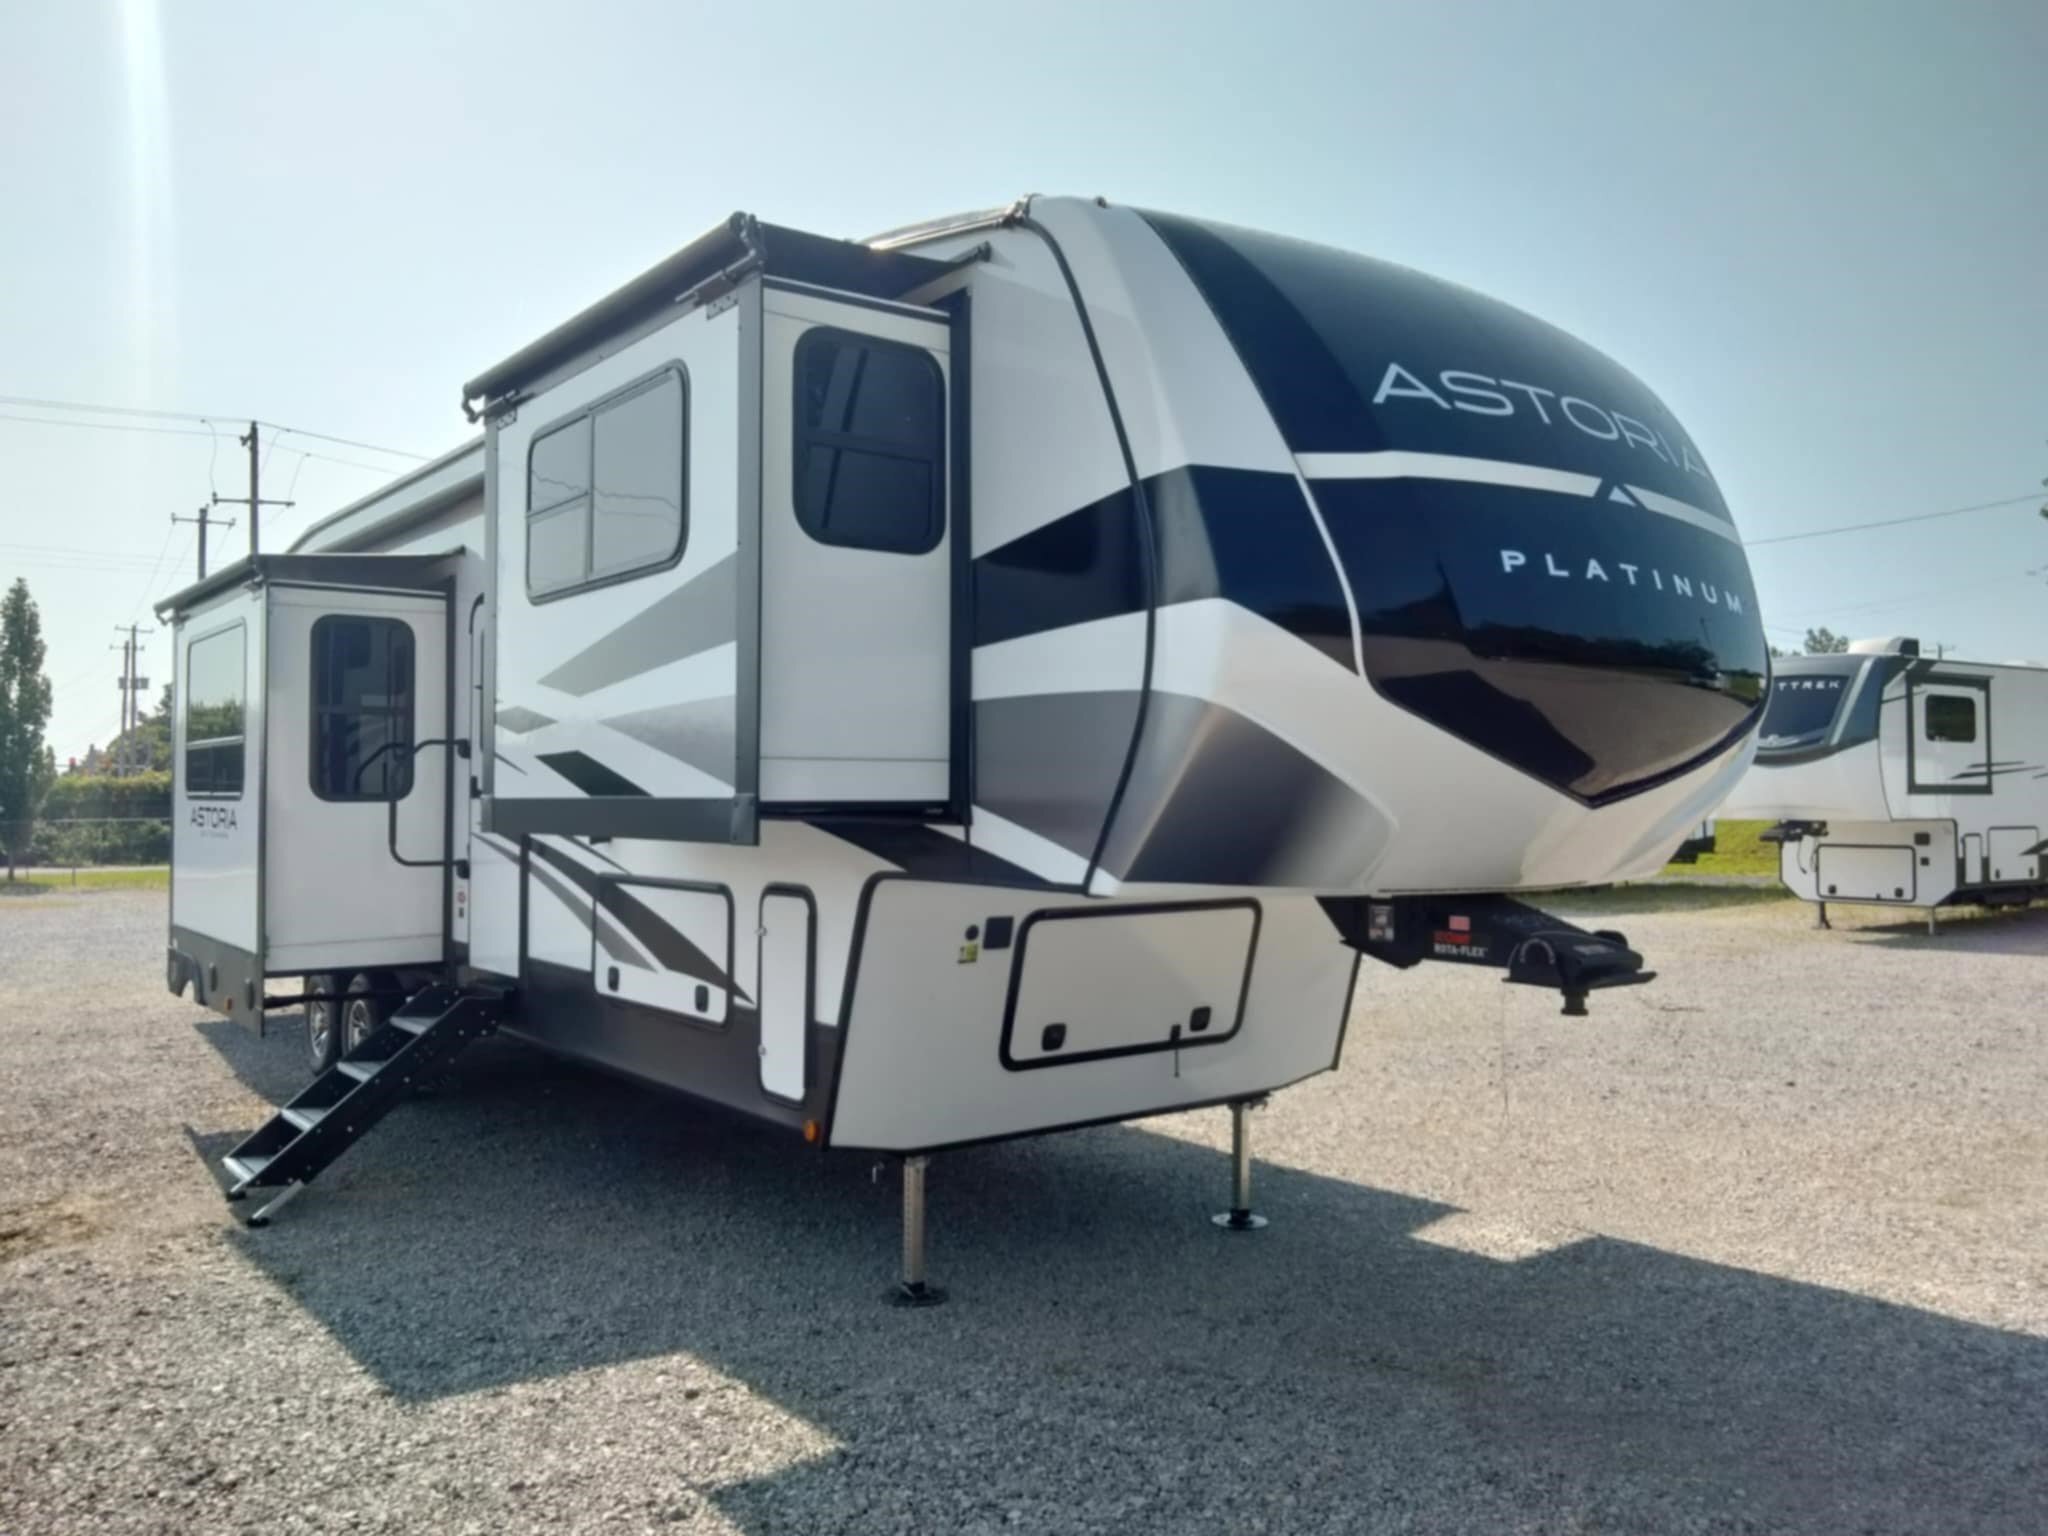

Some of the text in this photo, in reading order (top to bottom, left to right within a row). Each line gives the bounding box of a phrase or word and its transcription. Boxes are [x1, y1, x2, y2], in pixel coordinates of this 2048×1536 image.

[1372, 361, 1713, 482] ASTORIA
[1500, 549, 1744, 615] PLATINUM
[190, 806, 238, 829] ASTORIA
